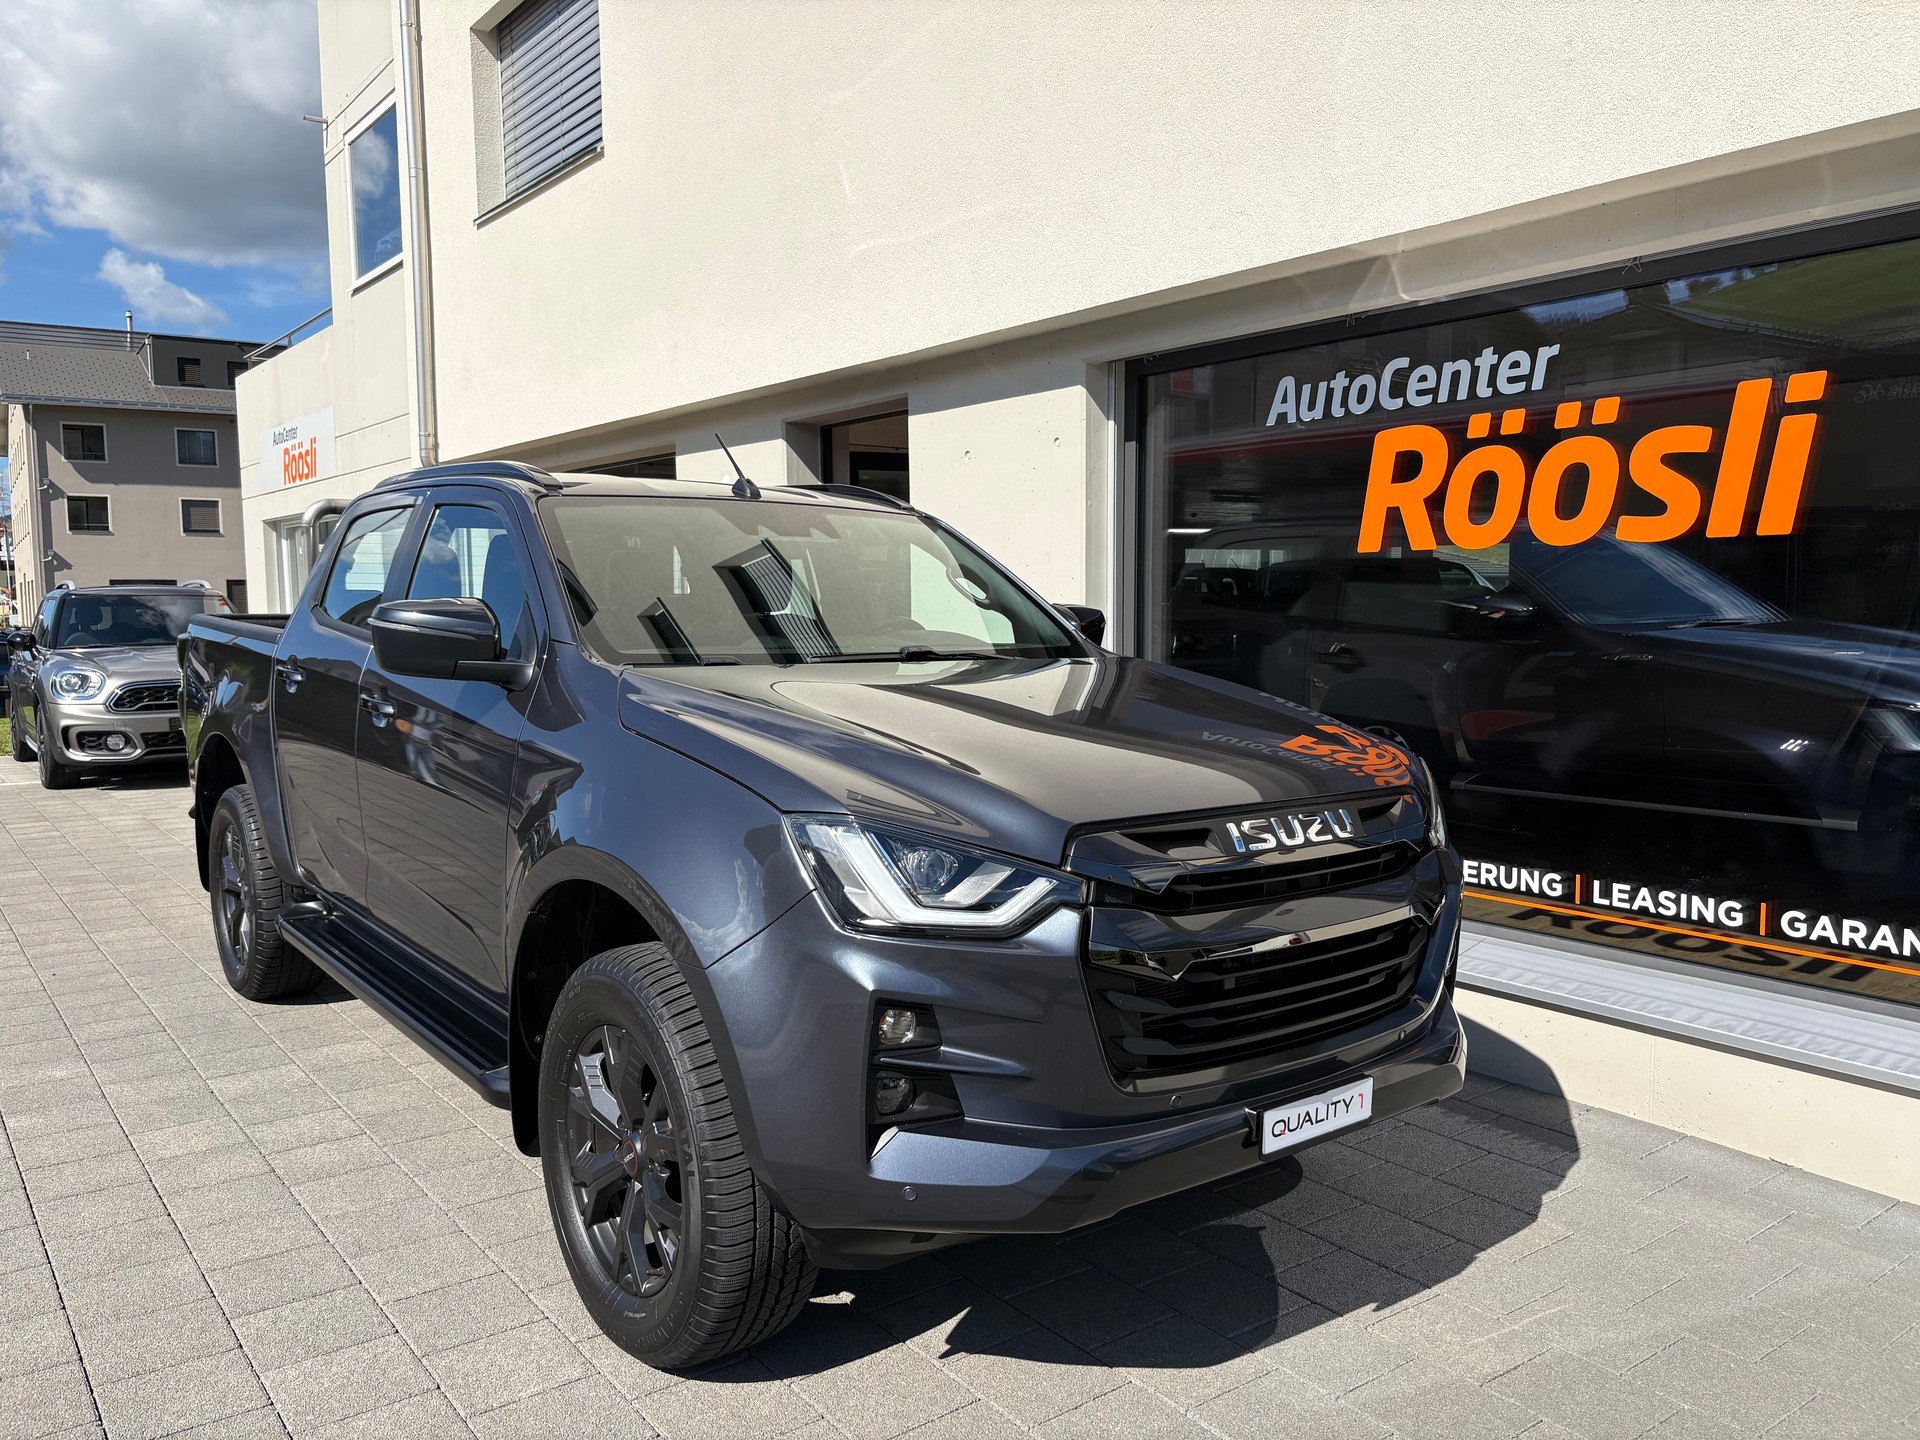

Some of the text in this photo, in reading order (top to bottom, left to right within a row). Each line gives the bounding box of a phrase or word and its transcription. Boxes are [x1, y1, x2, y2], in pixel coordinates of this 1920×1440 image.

[1266, 343, 1560, 426] AutoCenter
[272, 426, 298, 447] AutoCenter
[283, 436, 317, 486] Röösli
[1356, 369, 1828, 553] Röösli
[1225, 808, 1355, 853] ISUZU
[1463, 859, 1563, 897] ERUNG
[1593, 879, 1744, 927] LEASING
[1780, 910, 1920, 957] GARAN
[1271, 1095, 1355, 1138] QUALITY
